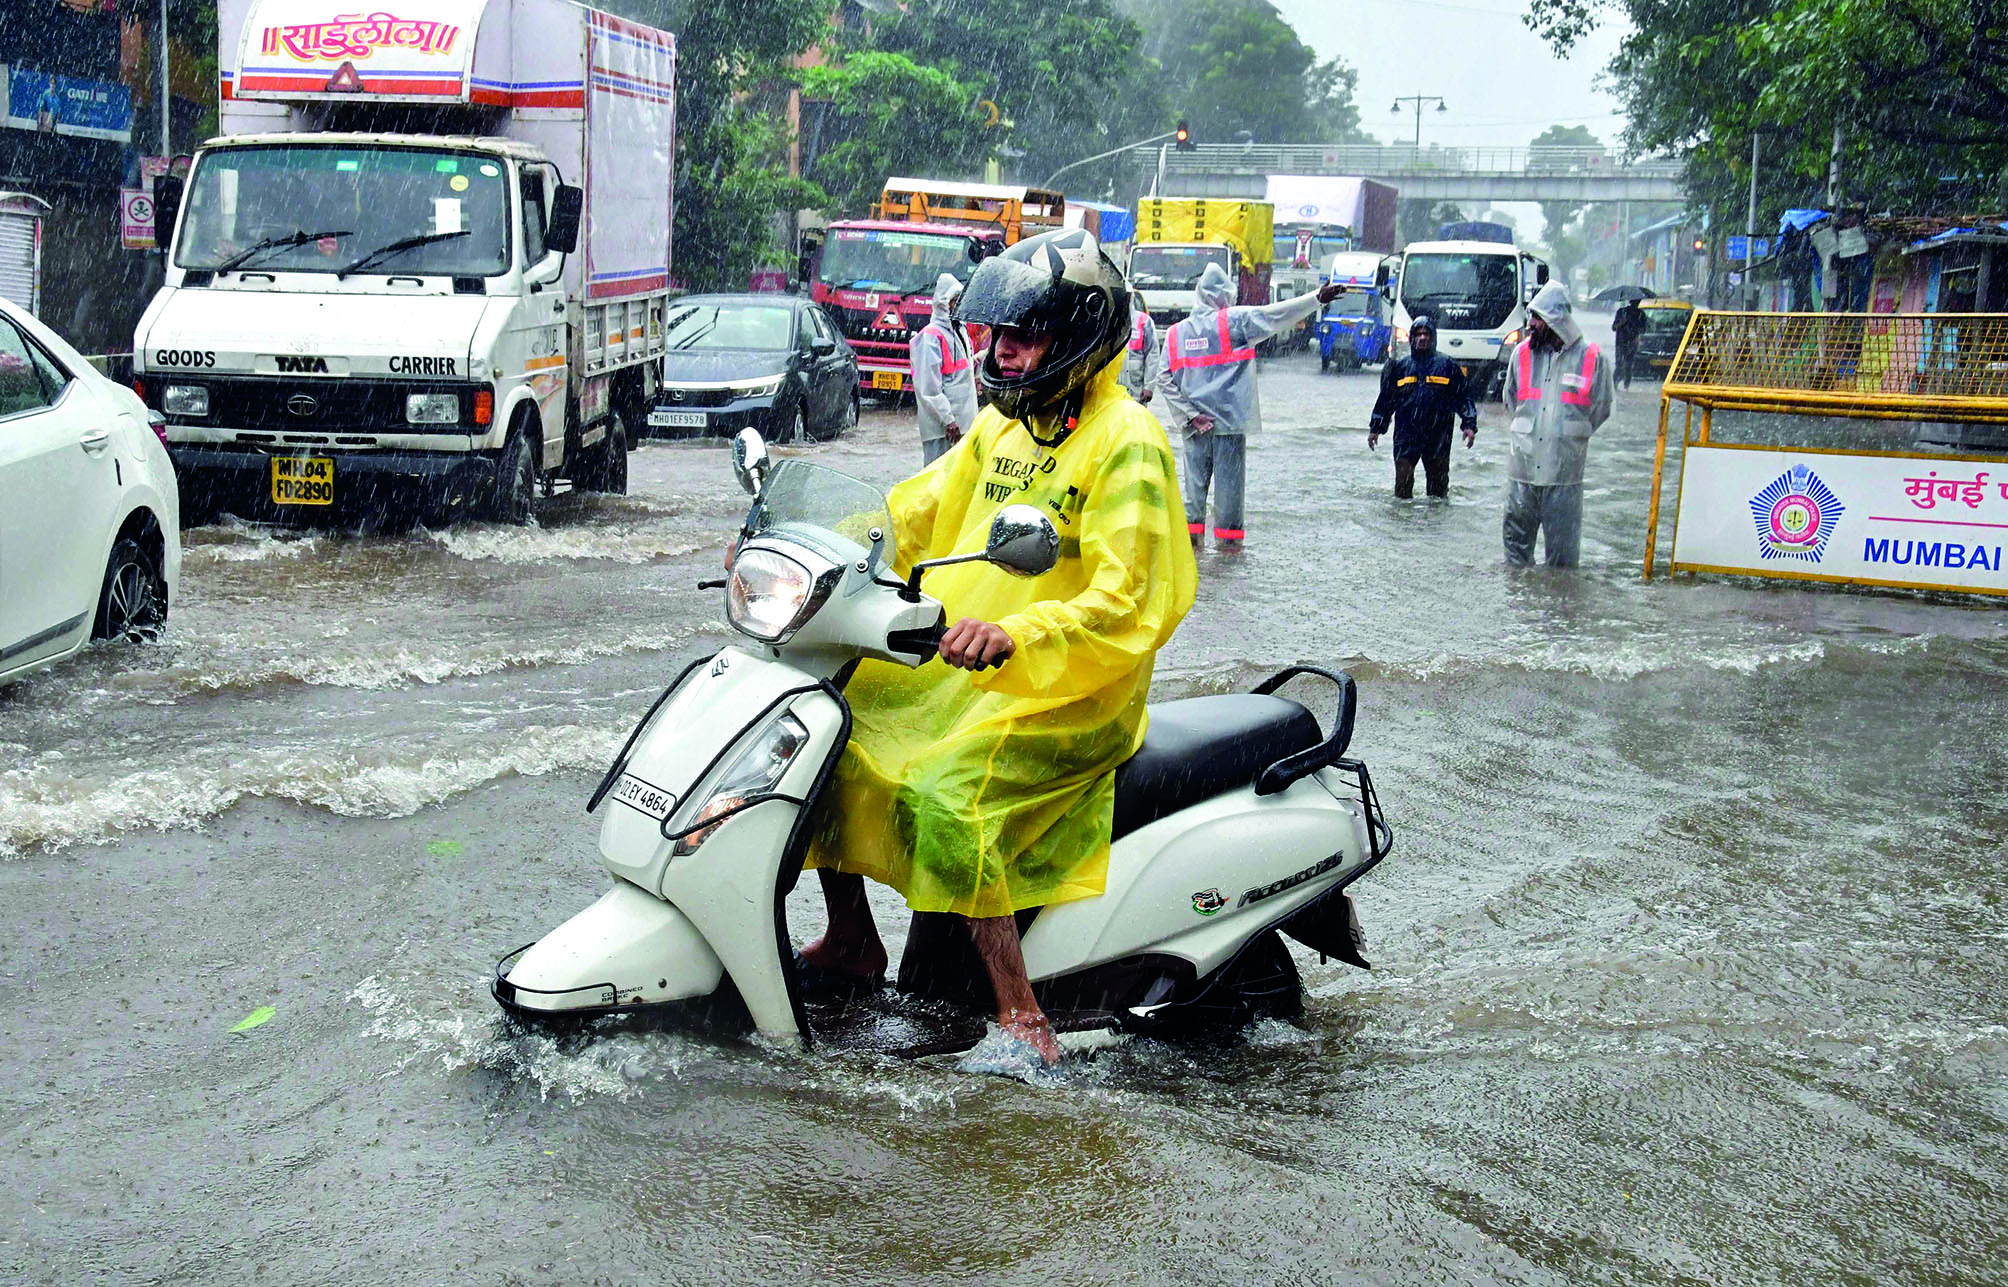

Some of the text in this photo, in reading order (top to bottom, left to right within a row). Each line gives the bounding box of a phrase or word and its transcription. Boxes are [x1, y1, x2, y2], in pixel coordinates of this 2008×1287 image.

[1445, 309, 1470, 317] TATA
[156, 350, 457, 376] GOODS TATA CARRIER
[654, 414, 705, 425] MH01EF9578
[277, 479, 332, 501] FD2890
[1903, 471, 1990, 509] मुंबई
[1864, 537, 2001, 571] MUMBAI
[628, 784, 643, 801] EY
[640, 790, 669, 815] 4864
[602, 993, 629, 1002] BRKE
